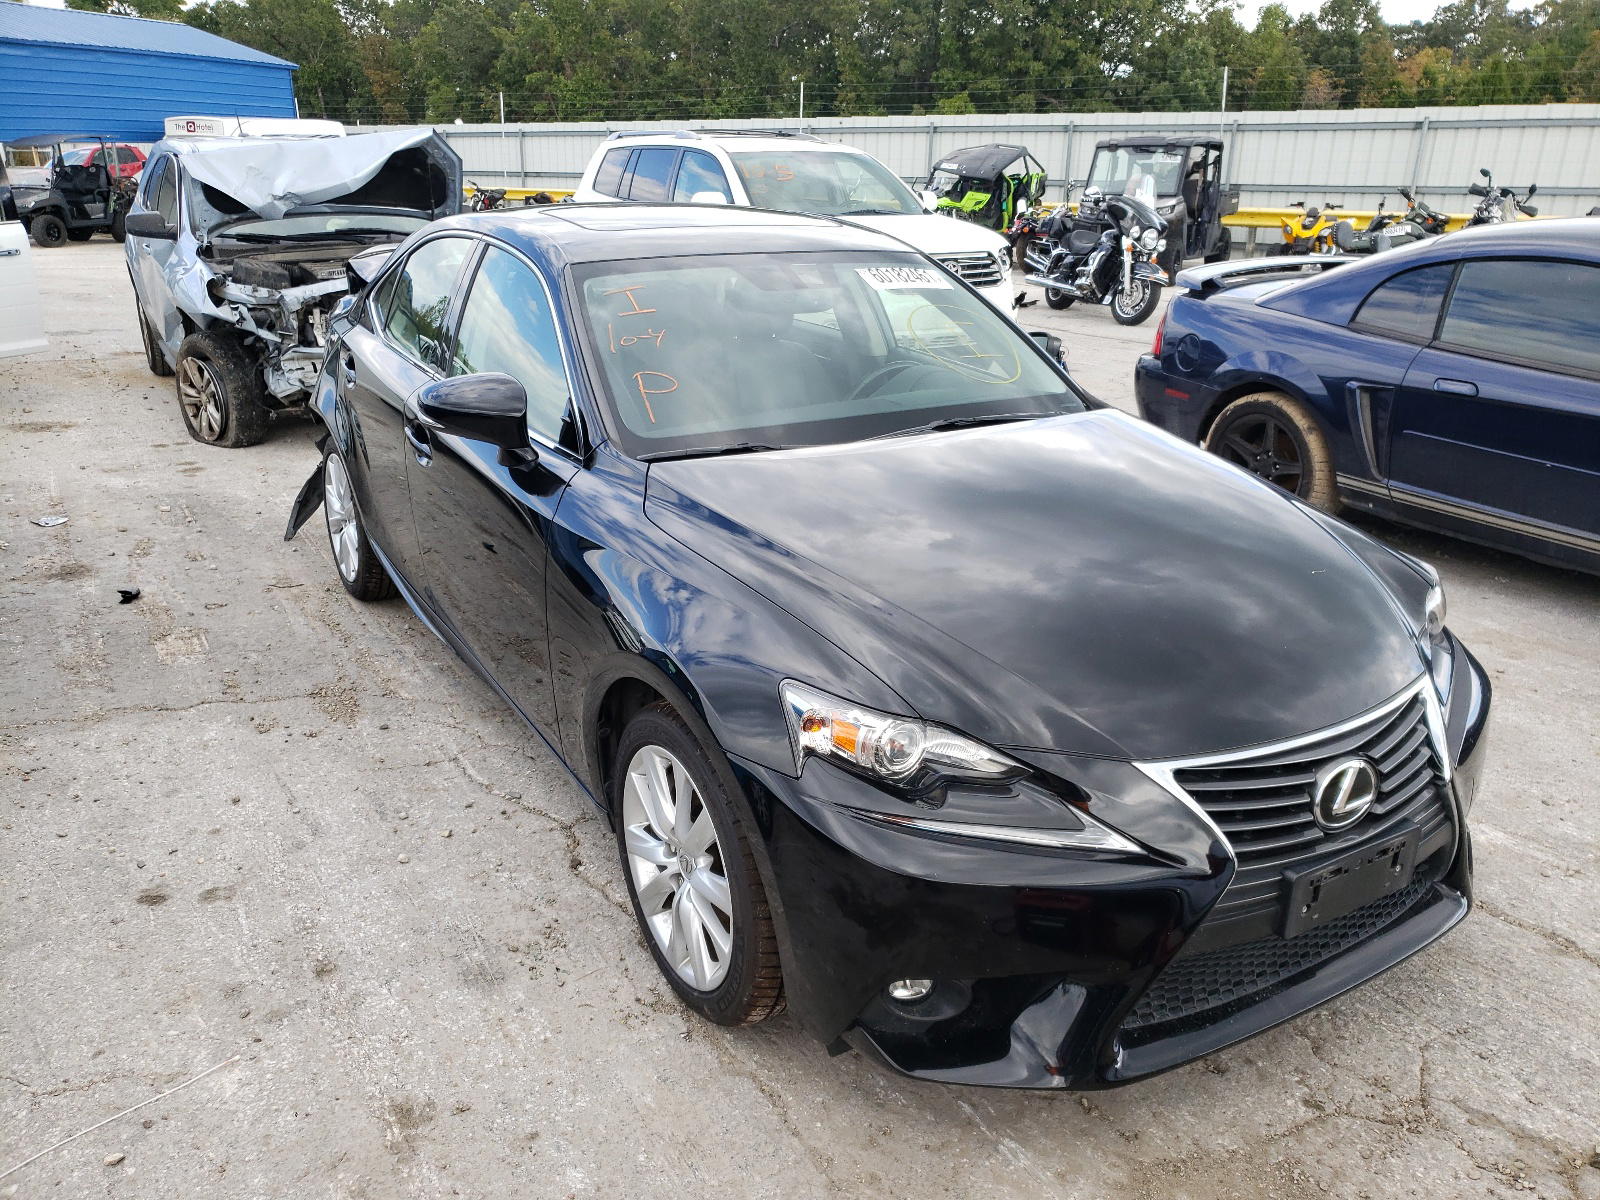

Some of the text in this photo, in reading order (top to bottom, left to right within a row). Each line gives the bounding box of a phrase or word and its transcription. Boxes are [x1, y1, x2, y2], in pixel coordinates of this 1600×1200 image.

[174, 123, 186, 131] The
[196, 123, 214, 131] Hotel
[632, 371, 680, 424] P
